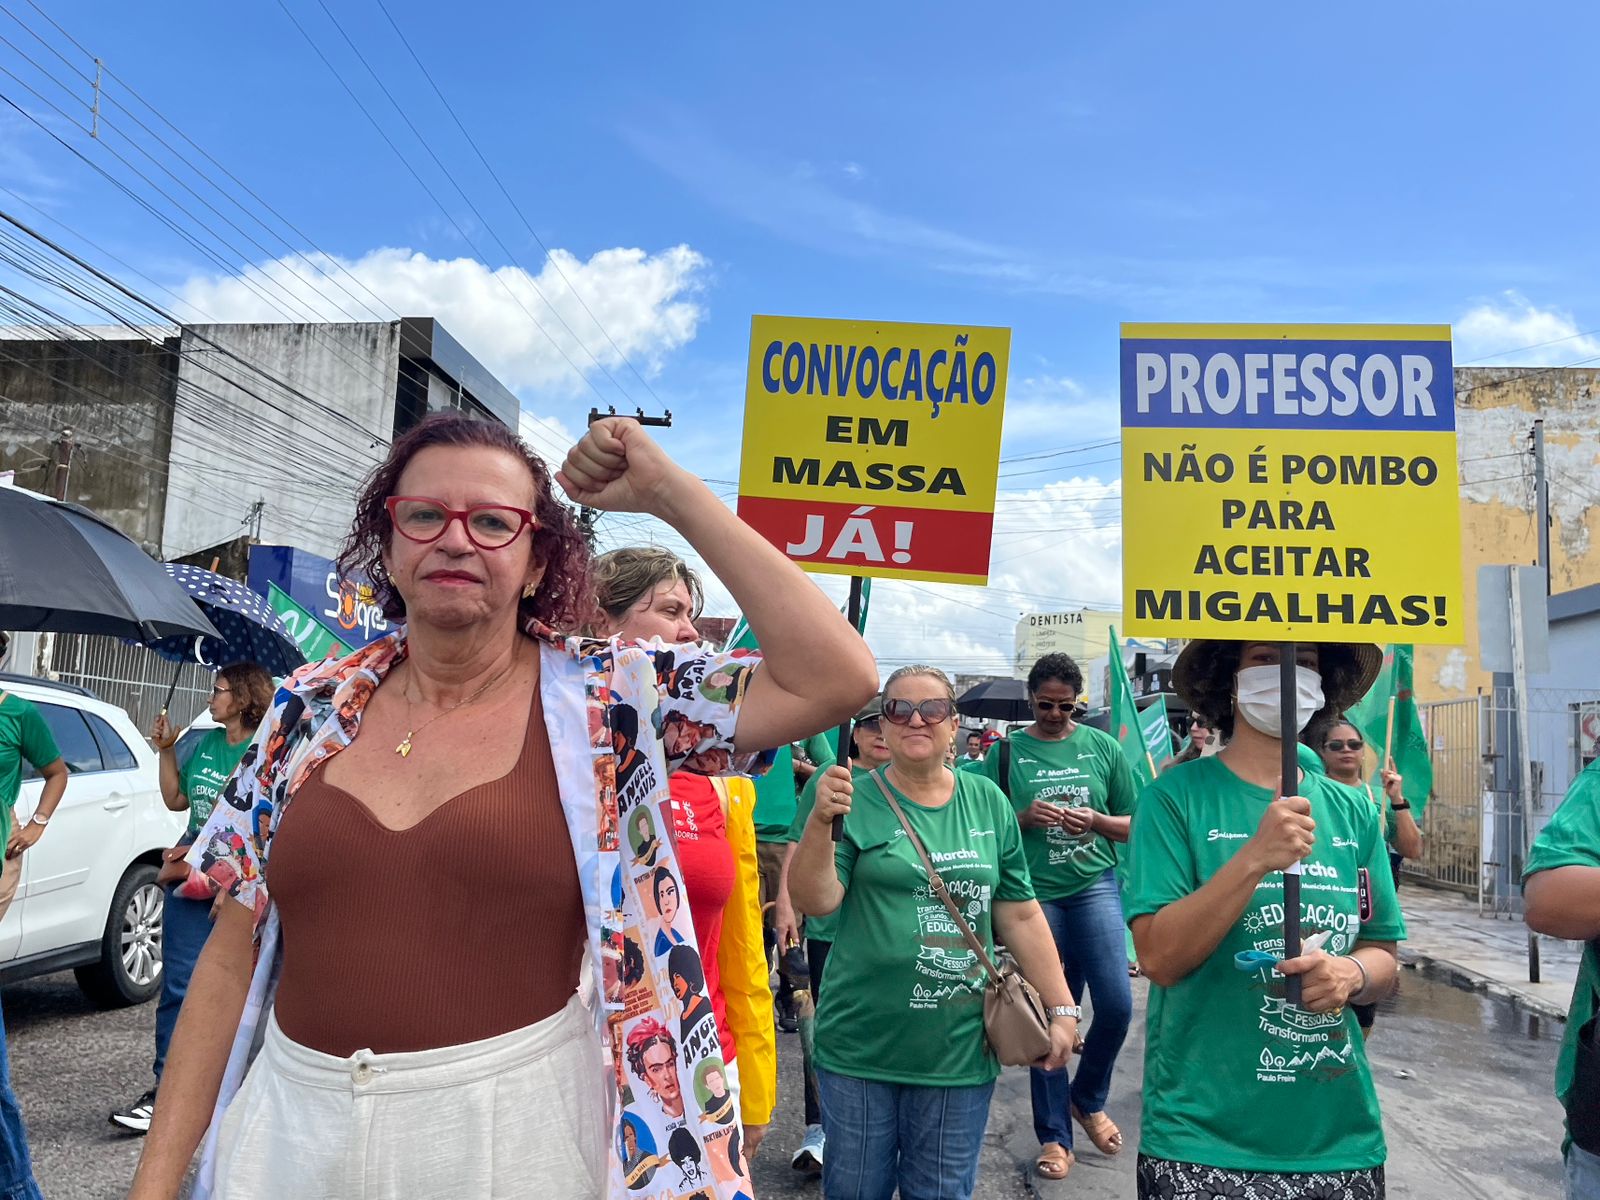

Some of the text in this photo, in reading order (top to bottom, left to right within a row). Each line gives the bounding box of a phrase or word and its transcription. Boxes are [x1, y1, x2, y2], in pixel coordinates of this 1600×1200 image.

[762, 333, 996, 419] CONVOCAÇÃO
[1136, 352, 1437, 417] PROFESSOR
[825, 415, 909, 447] EM
[772, 456, 967, 496] MASSA
[1143, 443, 1438, 486] NÃO É POMBO
[1222, 499, 1336, 530] PARA
[786, 505, 914, 564] JÁ!
[1193, 544, 1371, 578] ACEITAR
[1030, 613, 1083, 627] DENTISTA
[1135, 588, 1448, 627] MIGALHAS!
[1048, 767, 1080, 777] Marcha
[635, 772, 657, 807] DAVIS
[1041, 784, 1081, 798] EDUCAÇÃO
[931, 847, 979, 863] Marcha
[1256, 1072, 1296, 1082] Paulo Freire
